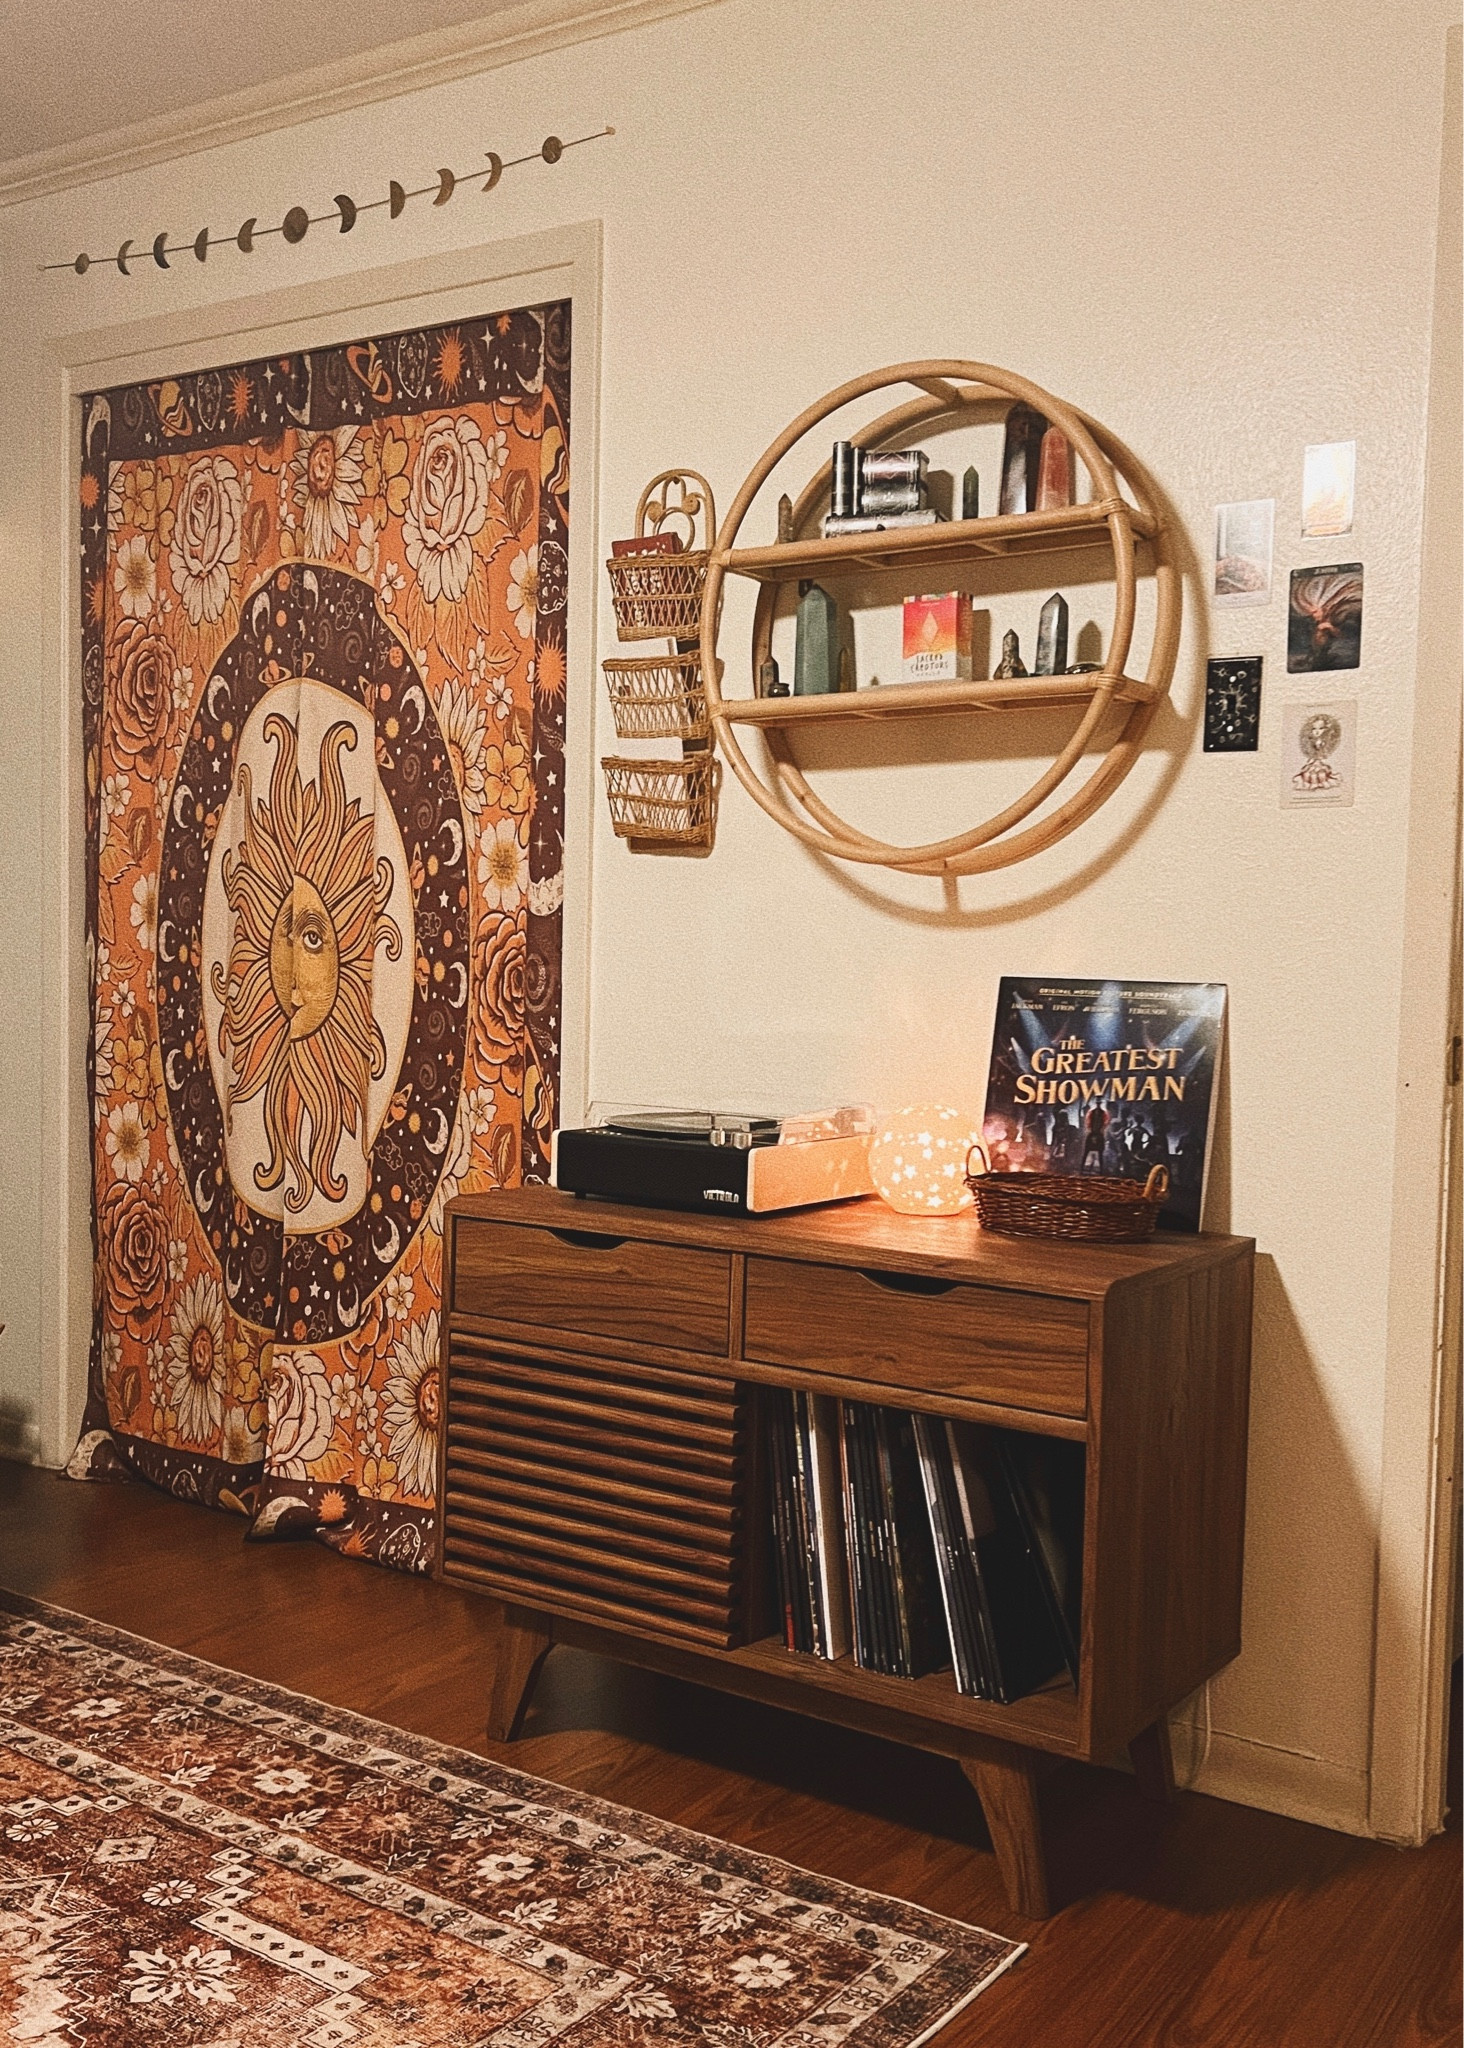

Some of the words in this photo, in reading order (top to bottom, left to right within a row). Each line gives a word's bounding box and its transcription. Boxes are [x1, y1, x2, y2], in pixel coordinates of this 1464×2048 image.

[1059, 1037, 1086, 1050] THE
[1031, 1046, 1184, 1074] GREATEST
[1014, 1074, 1187, 1105] SHOWMAN
